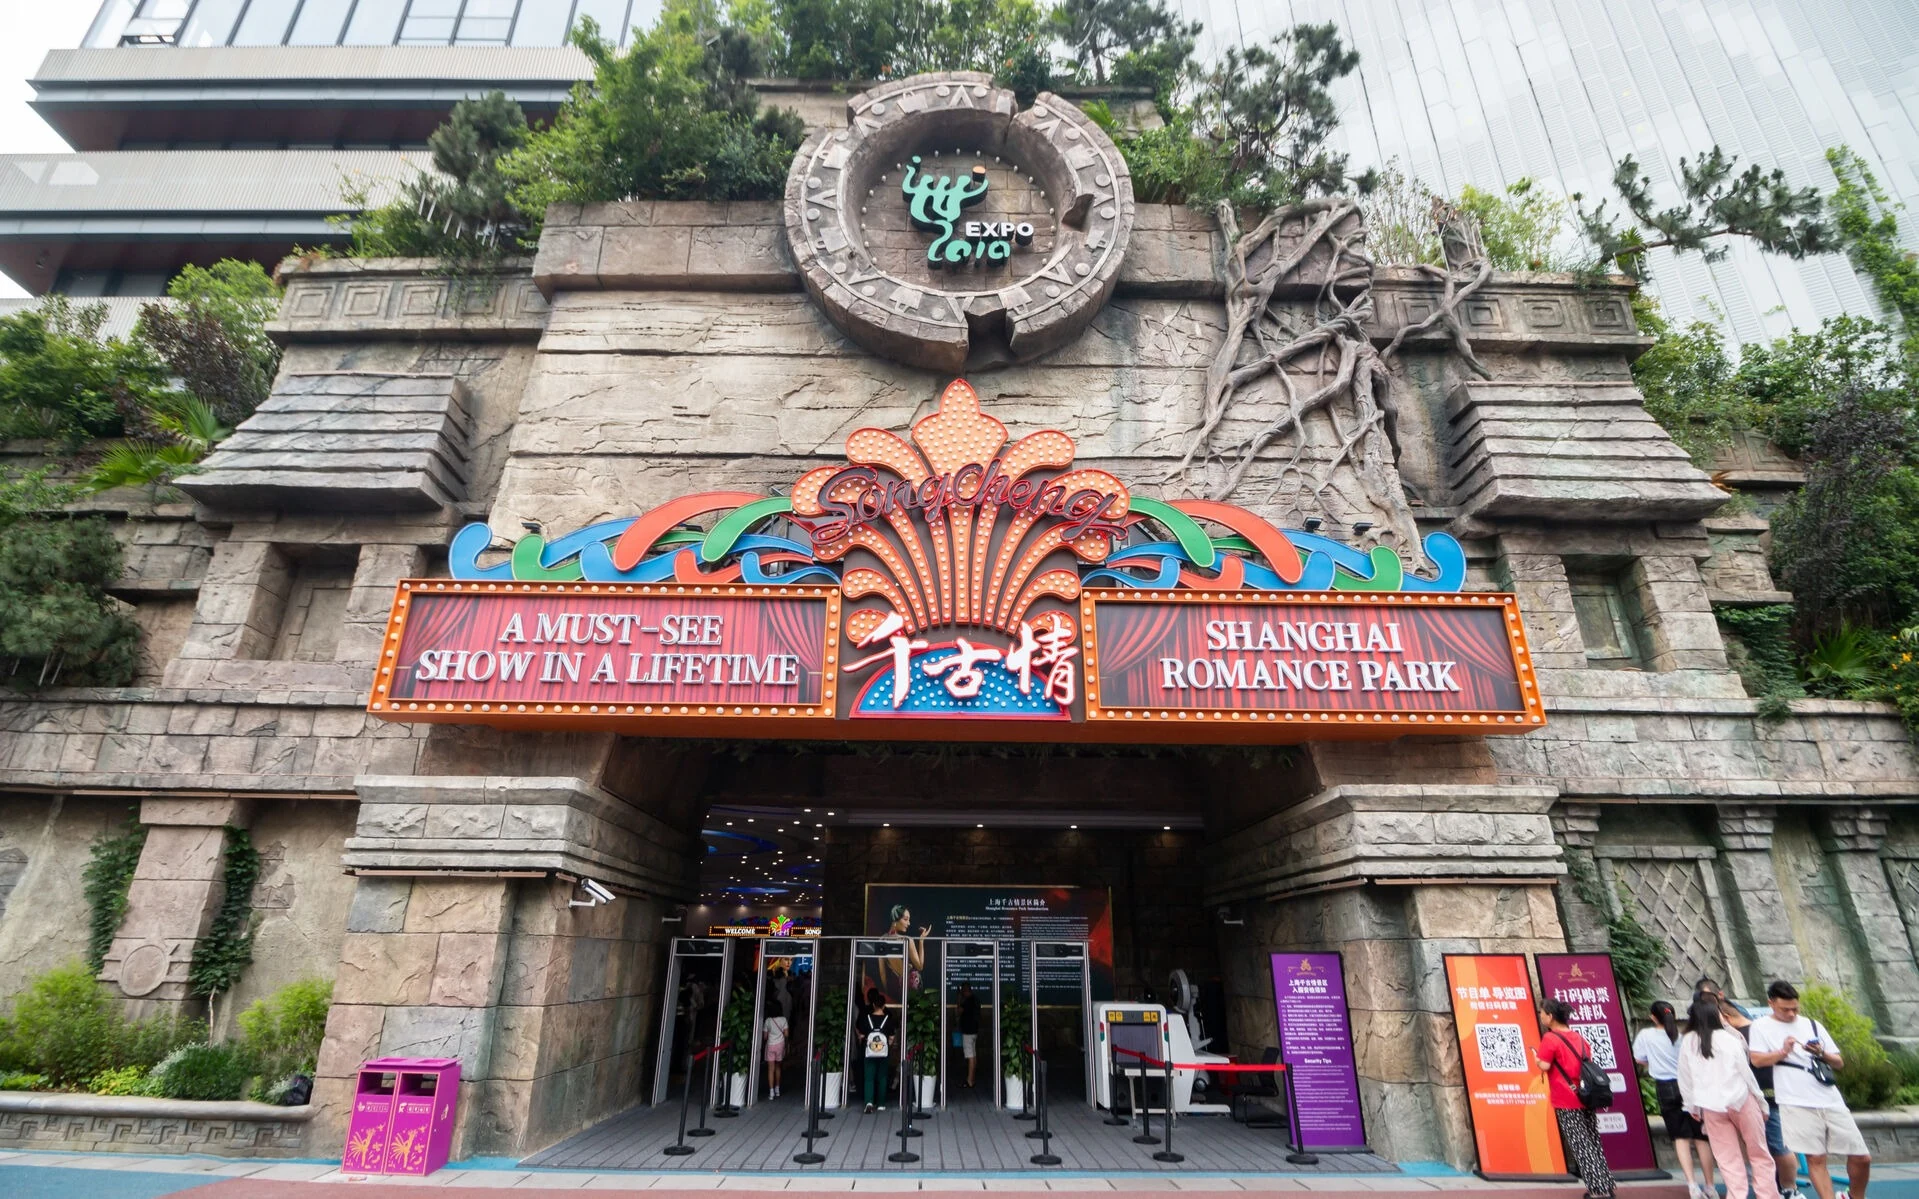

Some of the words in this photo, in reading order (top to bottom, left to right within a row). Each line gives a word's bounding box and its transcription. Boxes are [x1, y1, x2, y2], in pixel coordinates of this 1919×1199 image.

[965, 221, 1035, 238] EXPO
[499, 613, 525, 644] A
[532, 613, 725, 646] MUST-SEE
[1207, 620, 1405, 653] SHANGHAI
[415, 649, 536, 683] SHOW
[539, 651, 586, 684] IN
[590, 653, 617, 684] A
[625, 652, 801, 687] LIFETIME
[842, 610, 1079, 710] 千古情
[1160, 658, 1354, 691] ROMANCE
[1358, 660, 1463, 693] PARK
[1455, 986, 1491, 1000] 节目单
[1492, 986, 1527, 1000] 导览图
[1554, 986, 1610, 1004] 扫码购票
